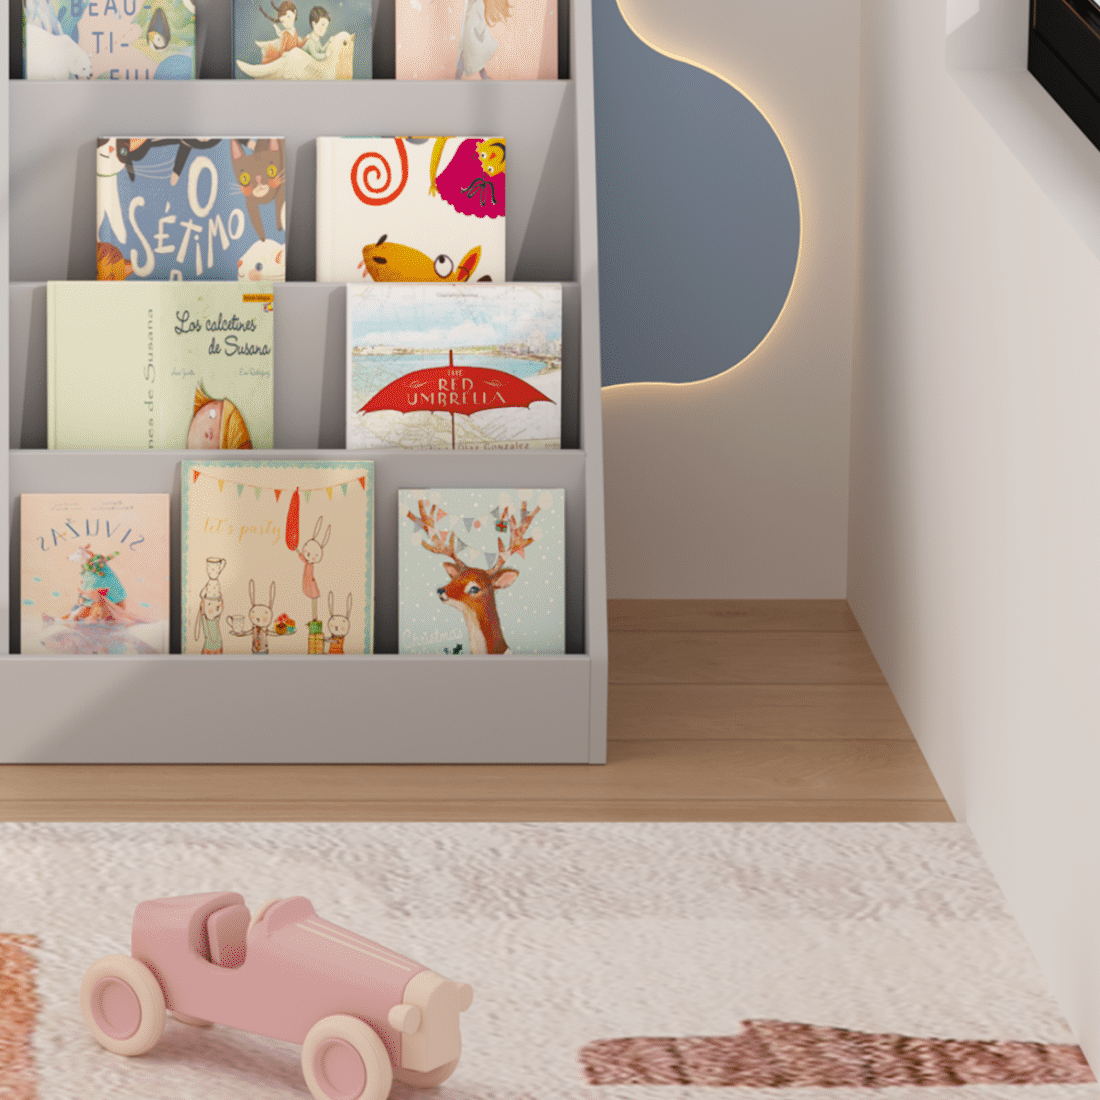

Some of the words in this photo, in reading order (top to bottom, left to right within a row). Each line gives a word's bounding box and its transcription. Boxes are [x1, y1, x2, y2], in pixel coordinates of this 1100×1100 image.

[92, 31, 130, 54] TI-
[187, 155, 218, 218] O
[174, 309, 202, 335] Los
[205, 312, 257, 332] calcetines
[143, 308, 156, 384] Susana
[208, 337, 222, 355] de
[224, 335, 271, 357] Susana
[438, 378, 474, 392] RED
[407, 391, 507, 407] UMBRELLA
